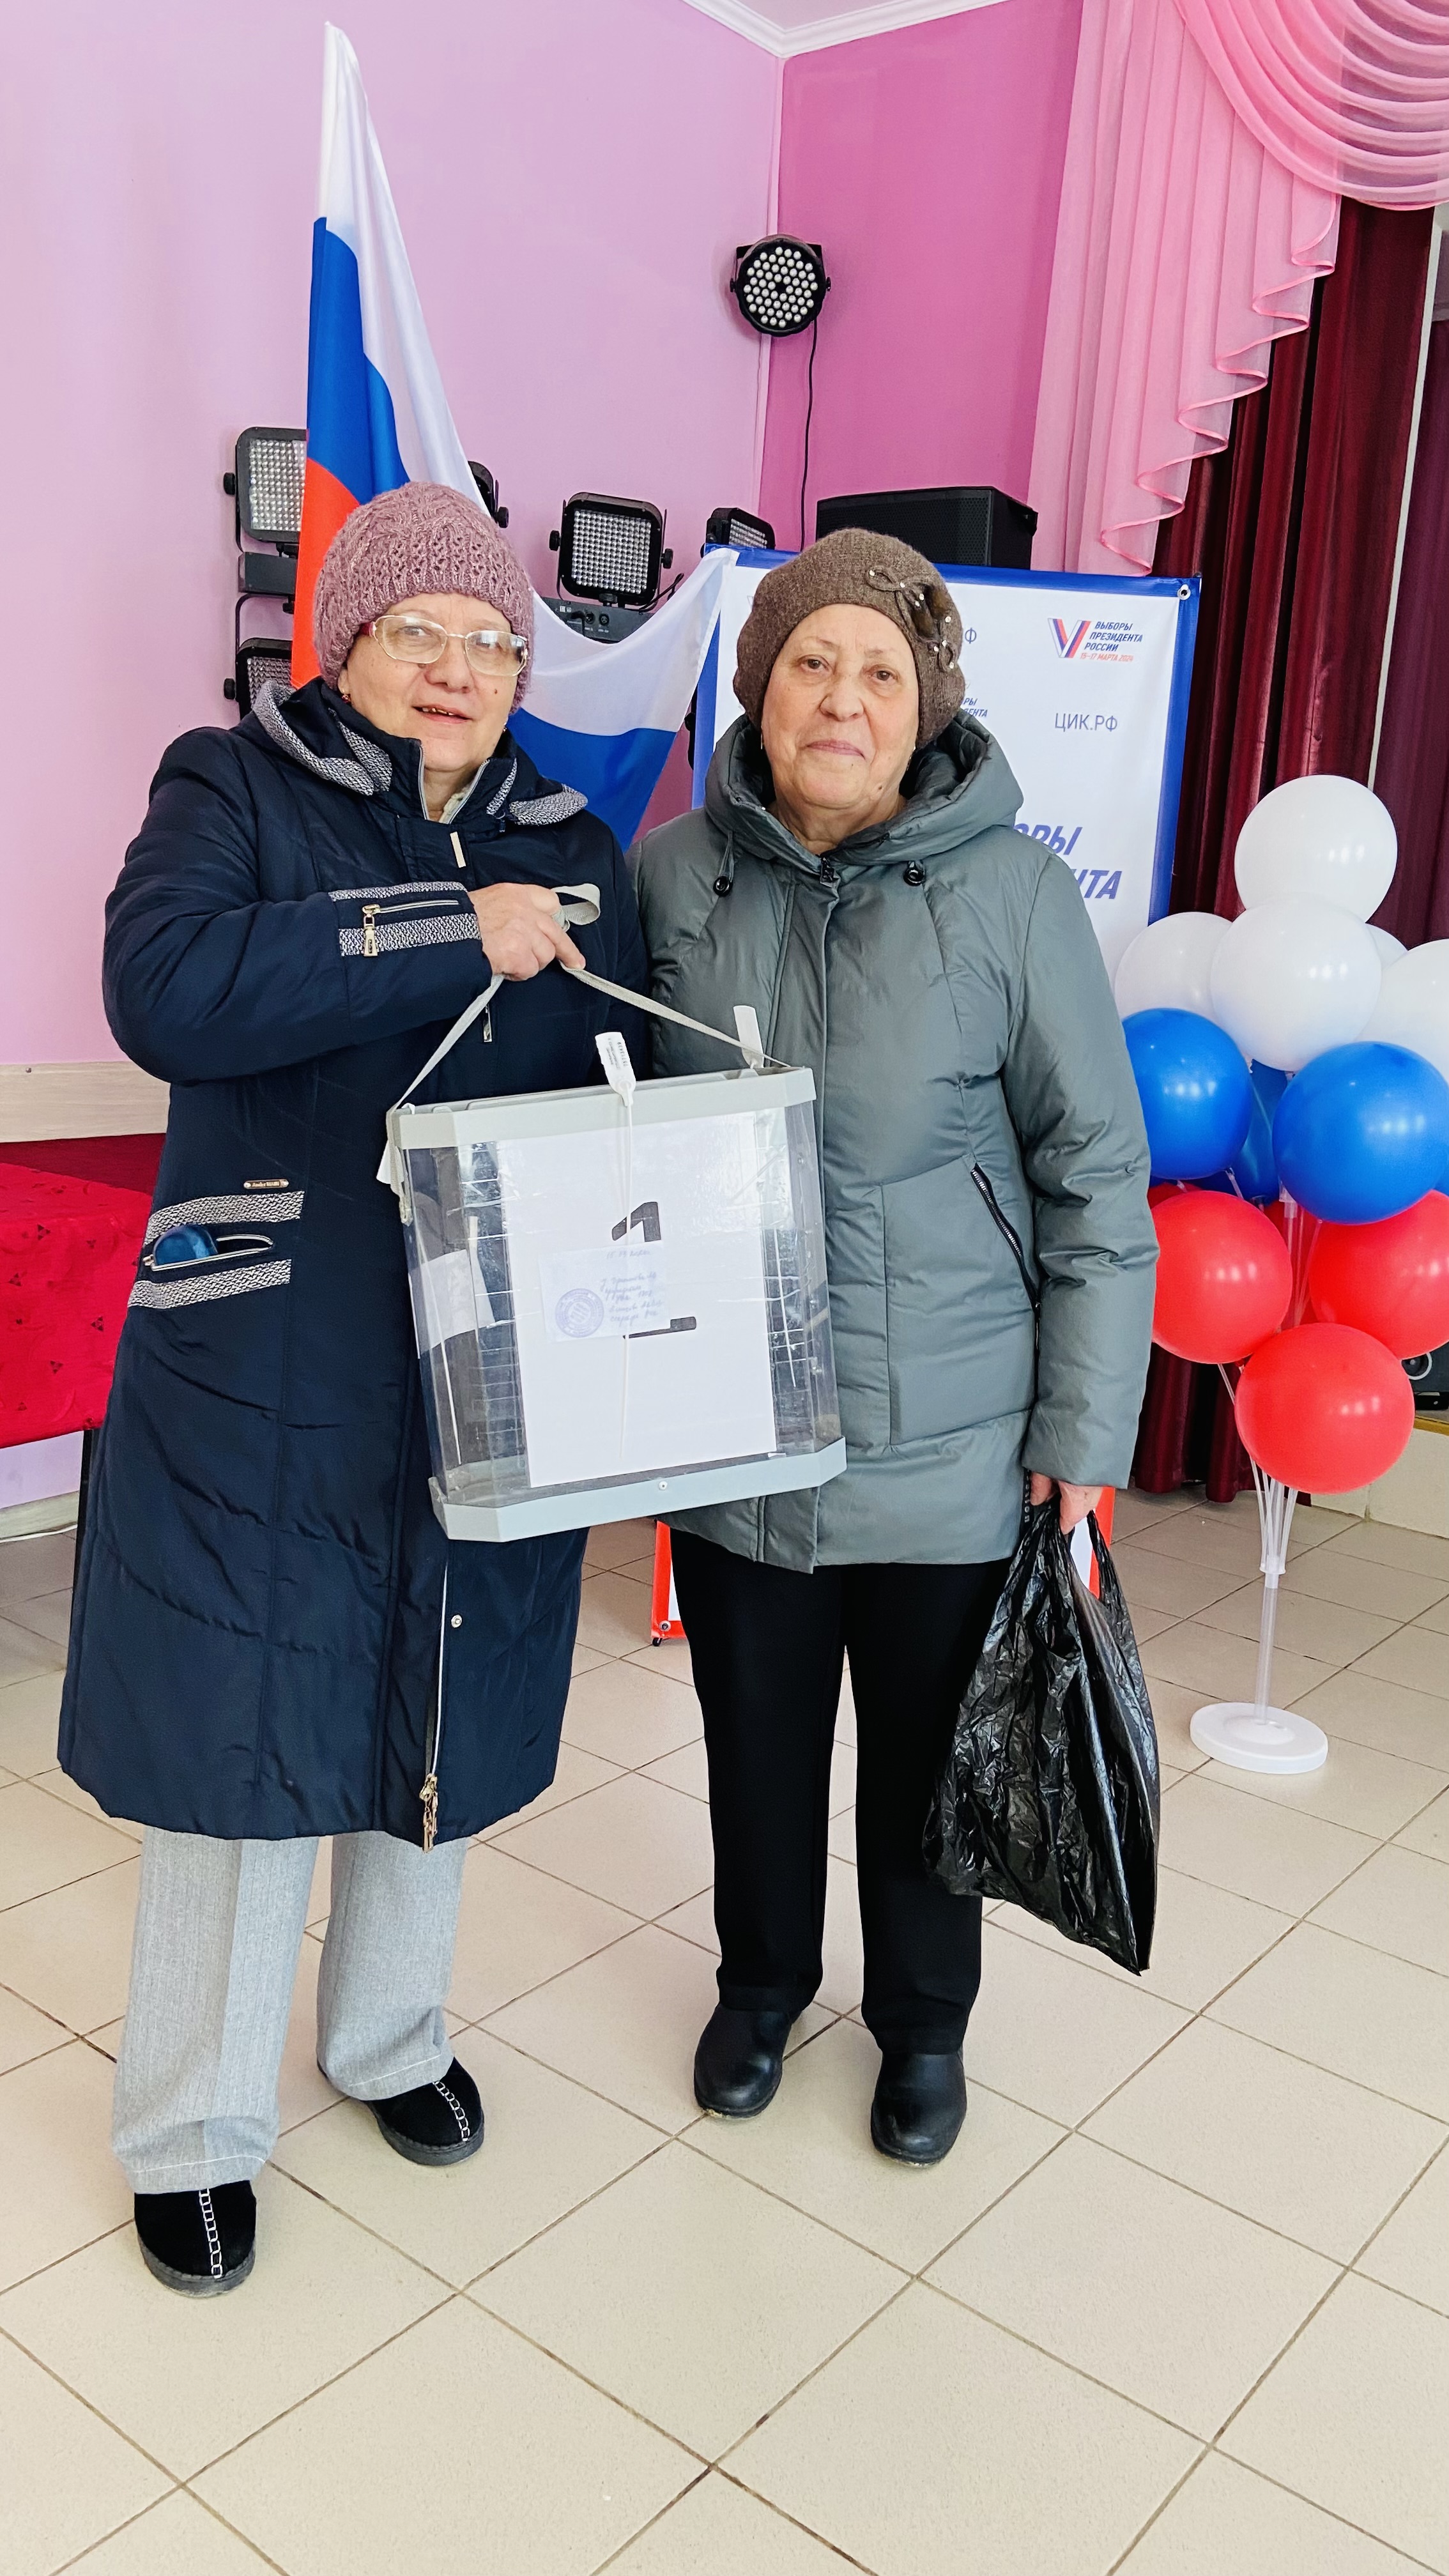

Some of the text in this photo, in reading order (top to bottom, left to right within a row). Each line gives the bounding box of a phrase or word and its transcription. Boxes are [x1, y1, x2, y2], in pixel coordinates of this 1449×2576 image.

[1094, 621, 1133, 631] ВЫБОРЫ
[1089, 632, 1143, 642] ПРЕЗИДЕНТА
[1084, 643, 1119, 652] РОССИИ
[1055, 713, 1117, 732] ЦИК.РФ
